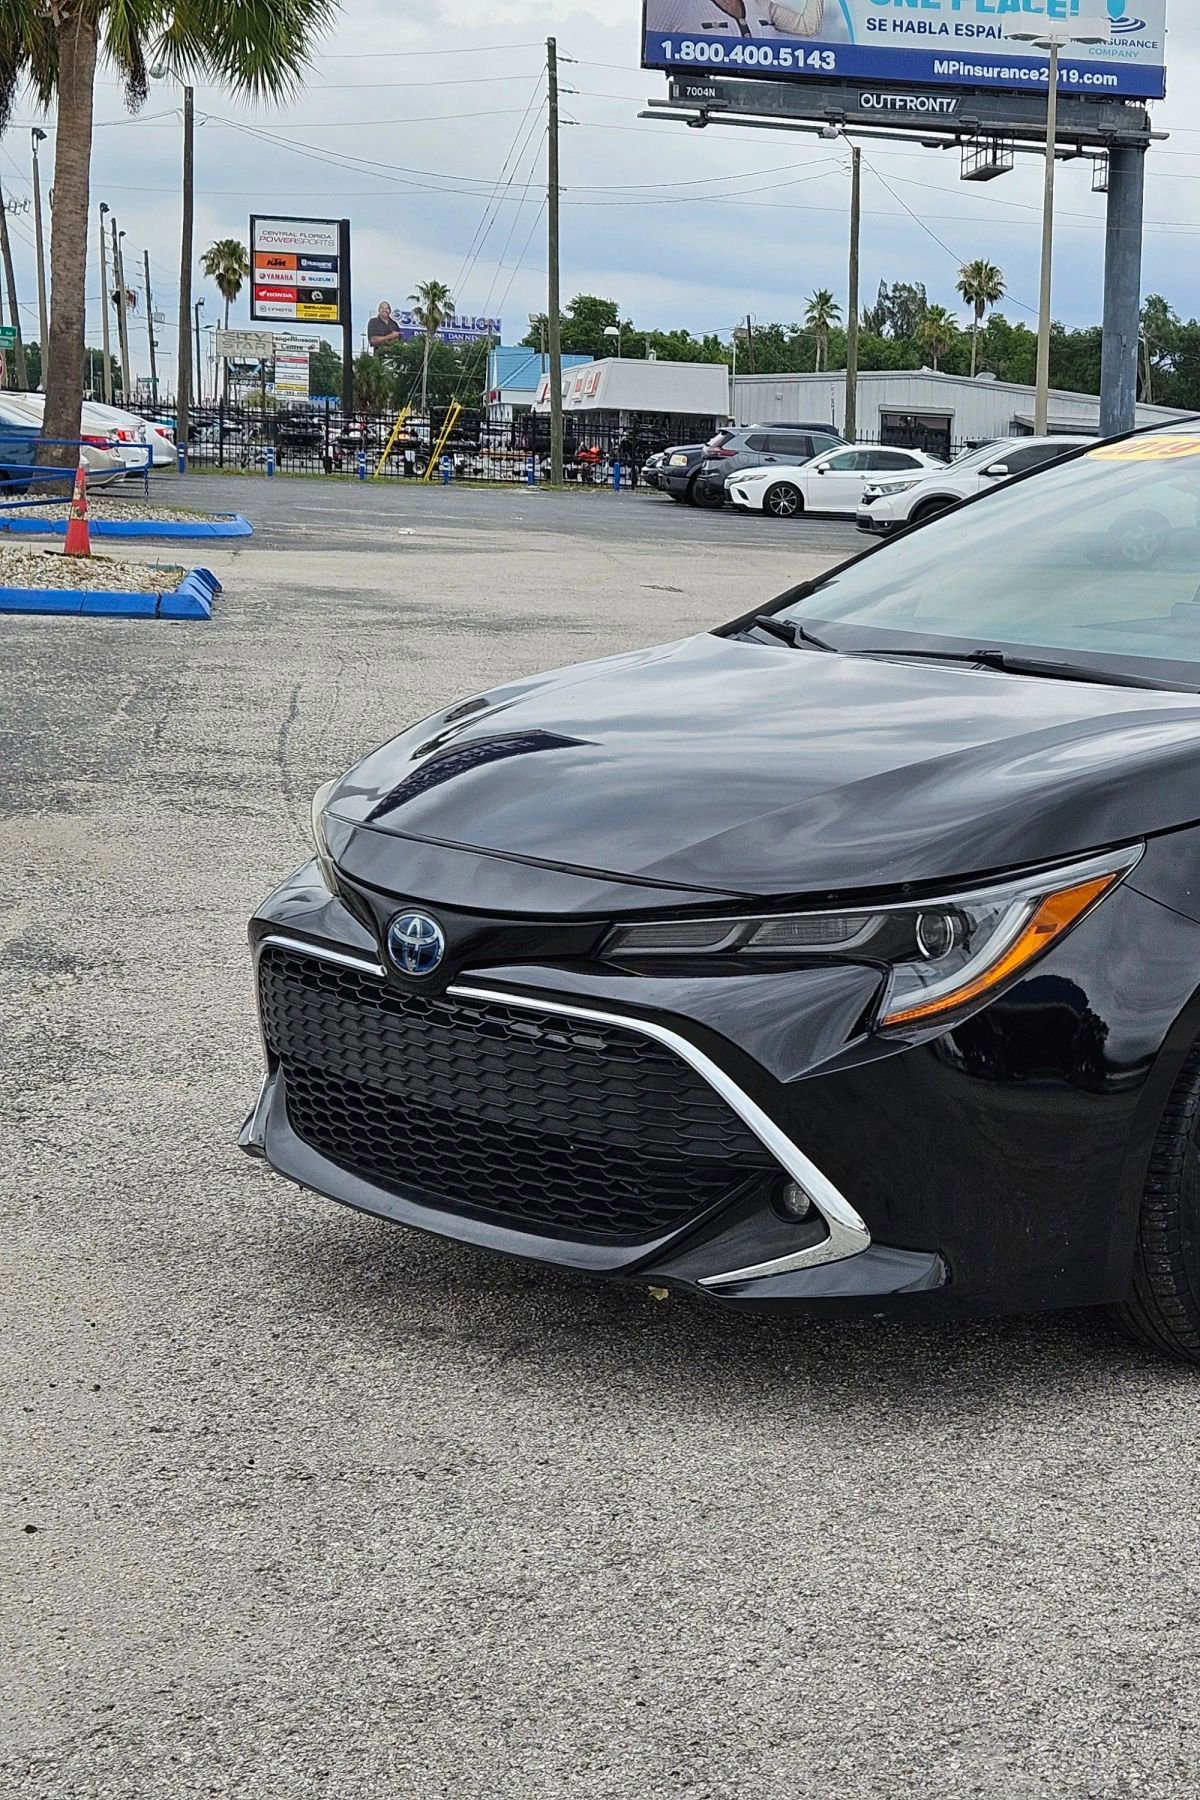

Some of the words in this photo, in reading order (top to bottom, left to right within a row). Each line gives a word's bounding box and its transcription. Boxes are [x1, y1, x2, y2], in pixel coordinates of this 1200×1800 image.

[866, 17, 888, 32] SE
[892, 20, 949, 36] HABLA
[954, 23, 1002, 40] ESPA
[1099, 38, 1159, 48] NSURANCE
[661, 40, 836, 70] 1.800.400.5143
[1088, 47, 1139, 58] COMPANY
[933, 60, 1118, 86] MPinsurance219.com
[686, 86, 716, 97] 7004N
[262, 230, 297, 238] CENTRAL
[300, 232, 332, 240] FLORIDA
[259, 236, 335, 247] POWERSPORTS
[266, 273, 293, 281] YAMAHA
[223, 340, 266, 350] STAR
